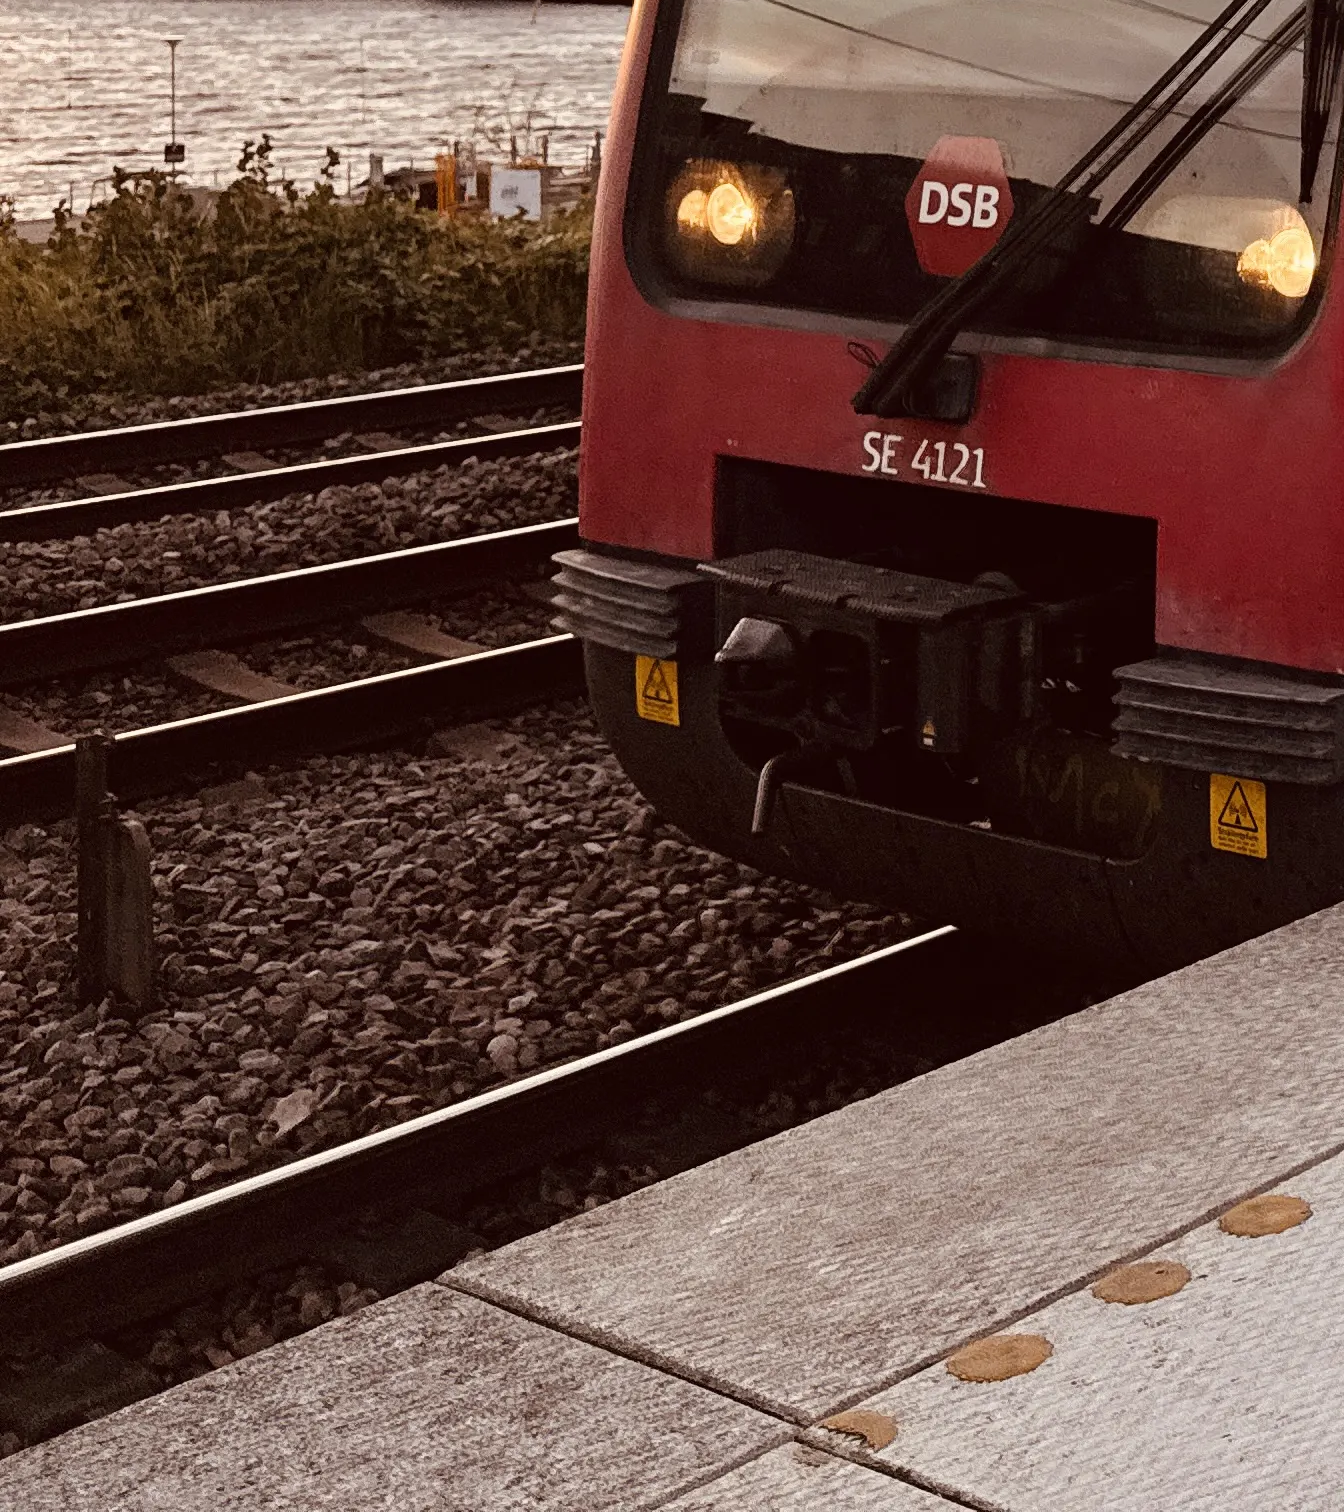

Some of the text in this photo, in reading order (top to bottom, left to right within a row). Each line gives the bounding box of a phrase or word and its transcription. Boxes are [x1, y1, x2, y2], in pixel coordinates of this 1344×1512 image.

[918, 180, 1000, 228] DSB
[861, 431, 986, 488] SE 4121
